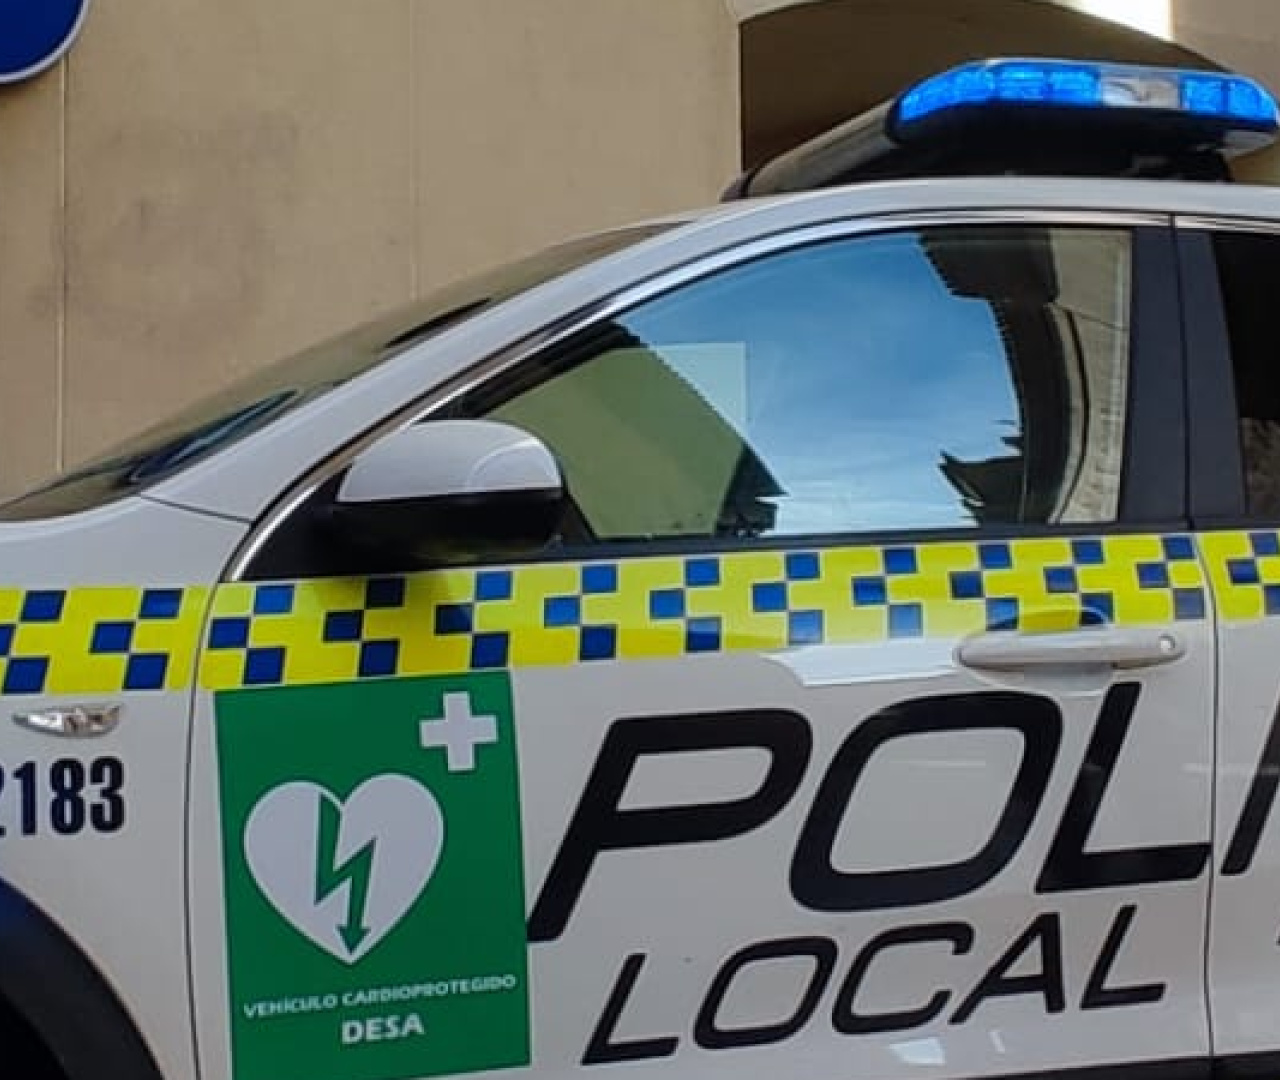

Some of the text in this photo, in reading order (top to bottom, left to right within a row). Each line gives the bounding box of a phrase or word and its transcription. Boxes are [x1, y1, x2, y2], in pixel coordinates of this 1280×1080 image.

[243, 974, 517, 1018] VEHÍCULO CARDIOPROTEGIDO
[583, 906, 1166, 1066] LOCAL
[341, 1013, 425, 1044] DESA
